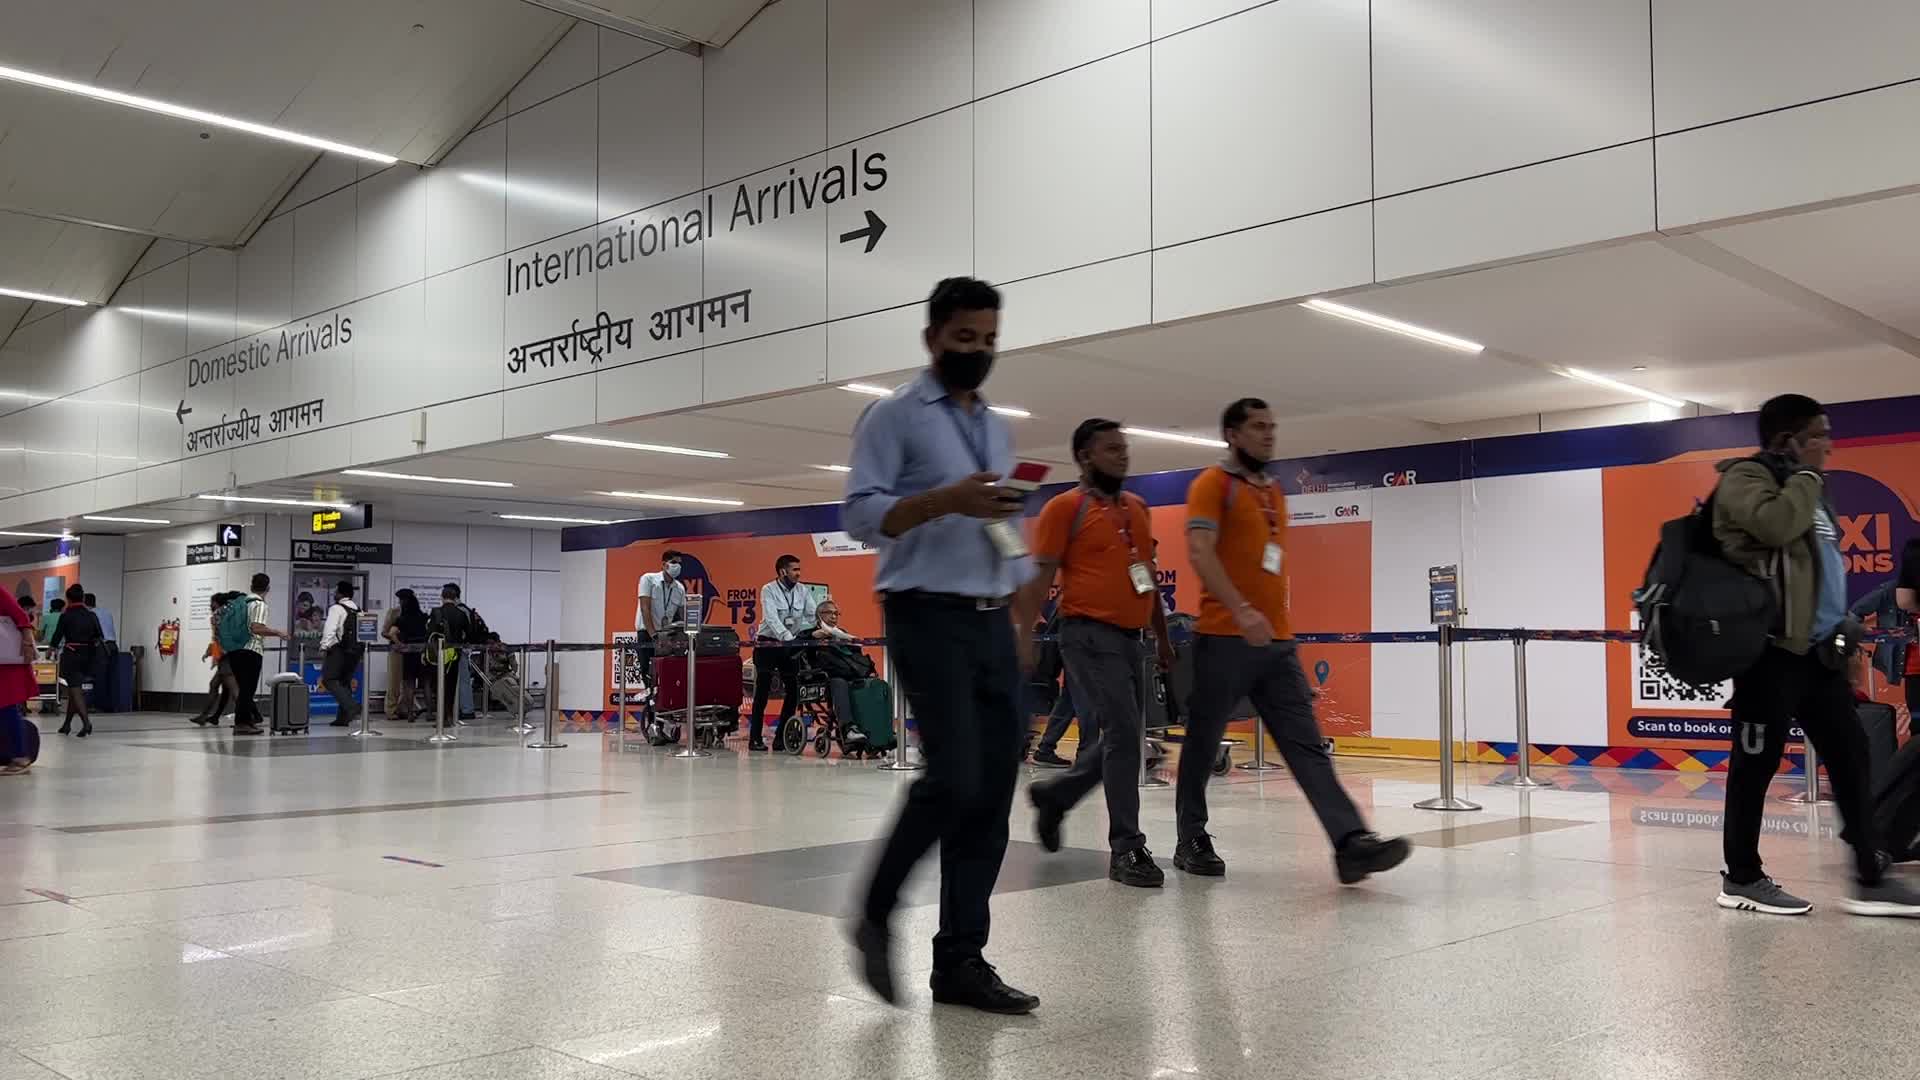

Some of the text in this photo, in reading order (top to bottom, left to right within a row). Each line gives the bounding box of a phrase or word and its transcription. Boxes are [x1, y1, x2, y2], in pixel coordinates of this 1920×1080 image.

[507, 148, 888, 296] International Arrivals
[507, 289, 752, 373] अन्तर्राष्ट्रीय आगमन
[188, 313, 352, 388] Domestic Arrivals
[186, 399, 324, 452] अन्तर्राज्यीय आगमन
[355, 545, 378, 553] Room
[1837, 513, 1891, 552] XI
[727, 588, 756, 600] FROM
[727, 601, 756, 624] T3
[1637, 720, 1666, 732] Scan
[1668, 722, 1682, 733] to
[1684, 721, 1717, 734] book
[1741, 721, 1767, 754] U
